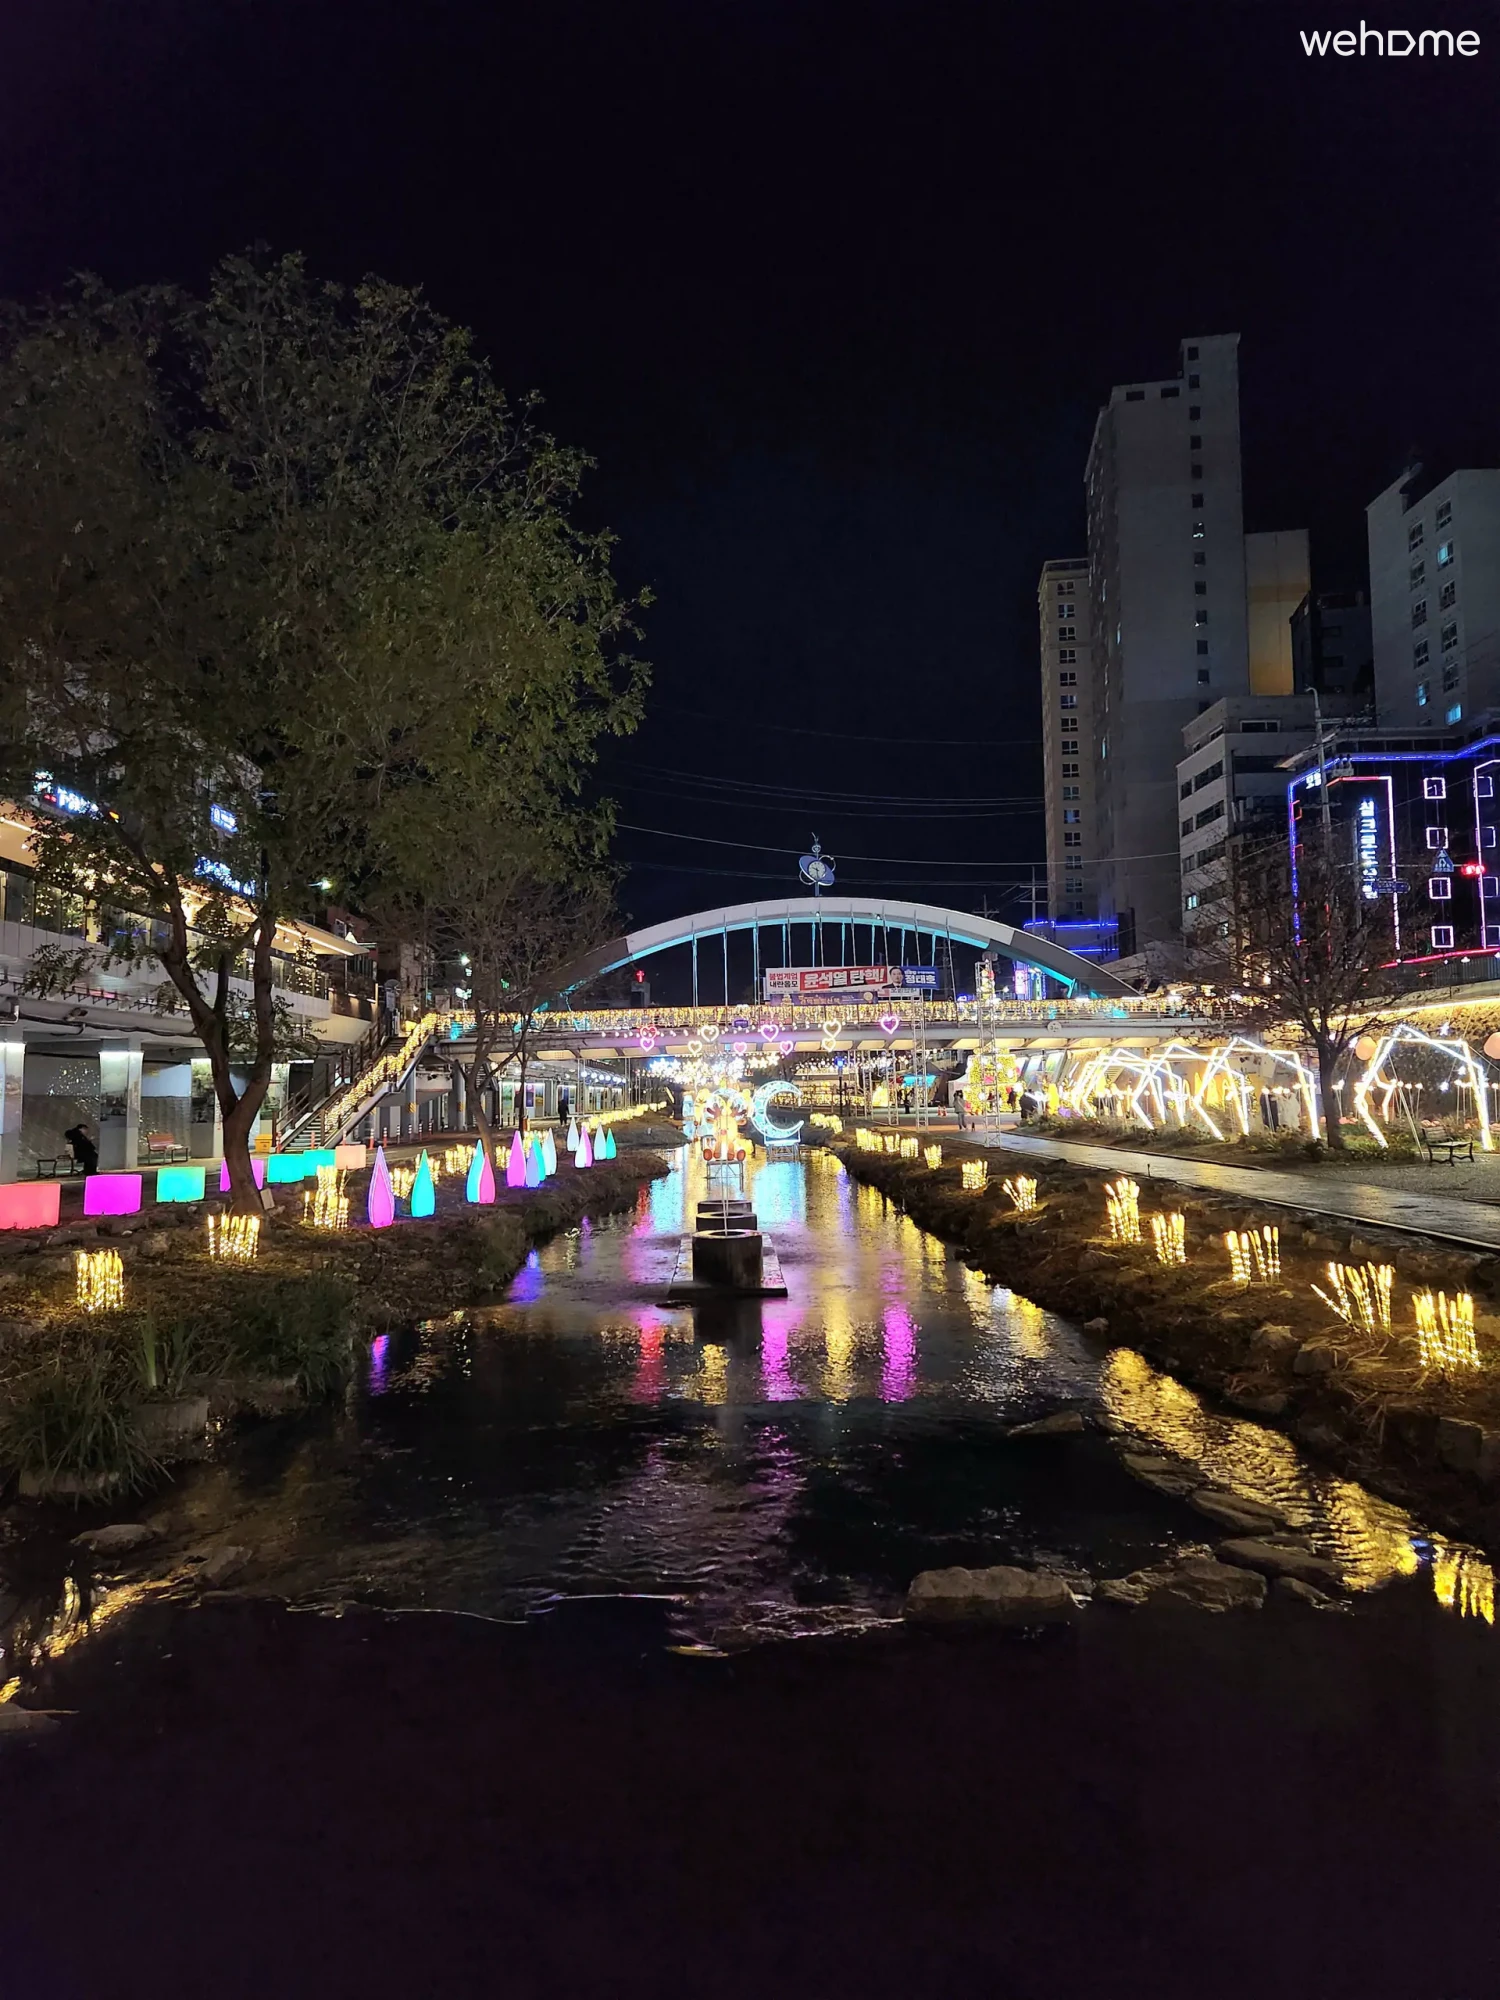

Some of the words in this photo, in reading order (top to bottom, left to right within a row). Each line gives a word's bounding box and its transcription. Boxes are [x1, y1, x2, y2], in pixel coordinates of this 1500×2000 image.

[768, 972, 798, 981] 불법계엄
[804, 971, 847, 989] 윤석열
[850, 968, 884, 985] 탄핵!
[905, 974, 936, 985] 정태호
